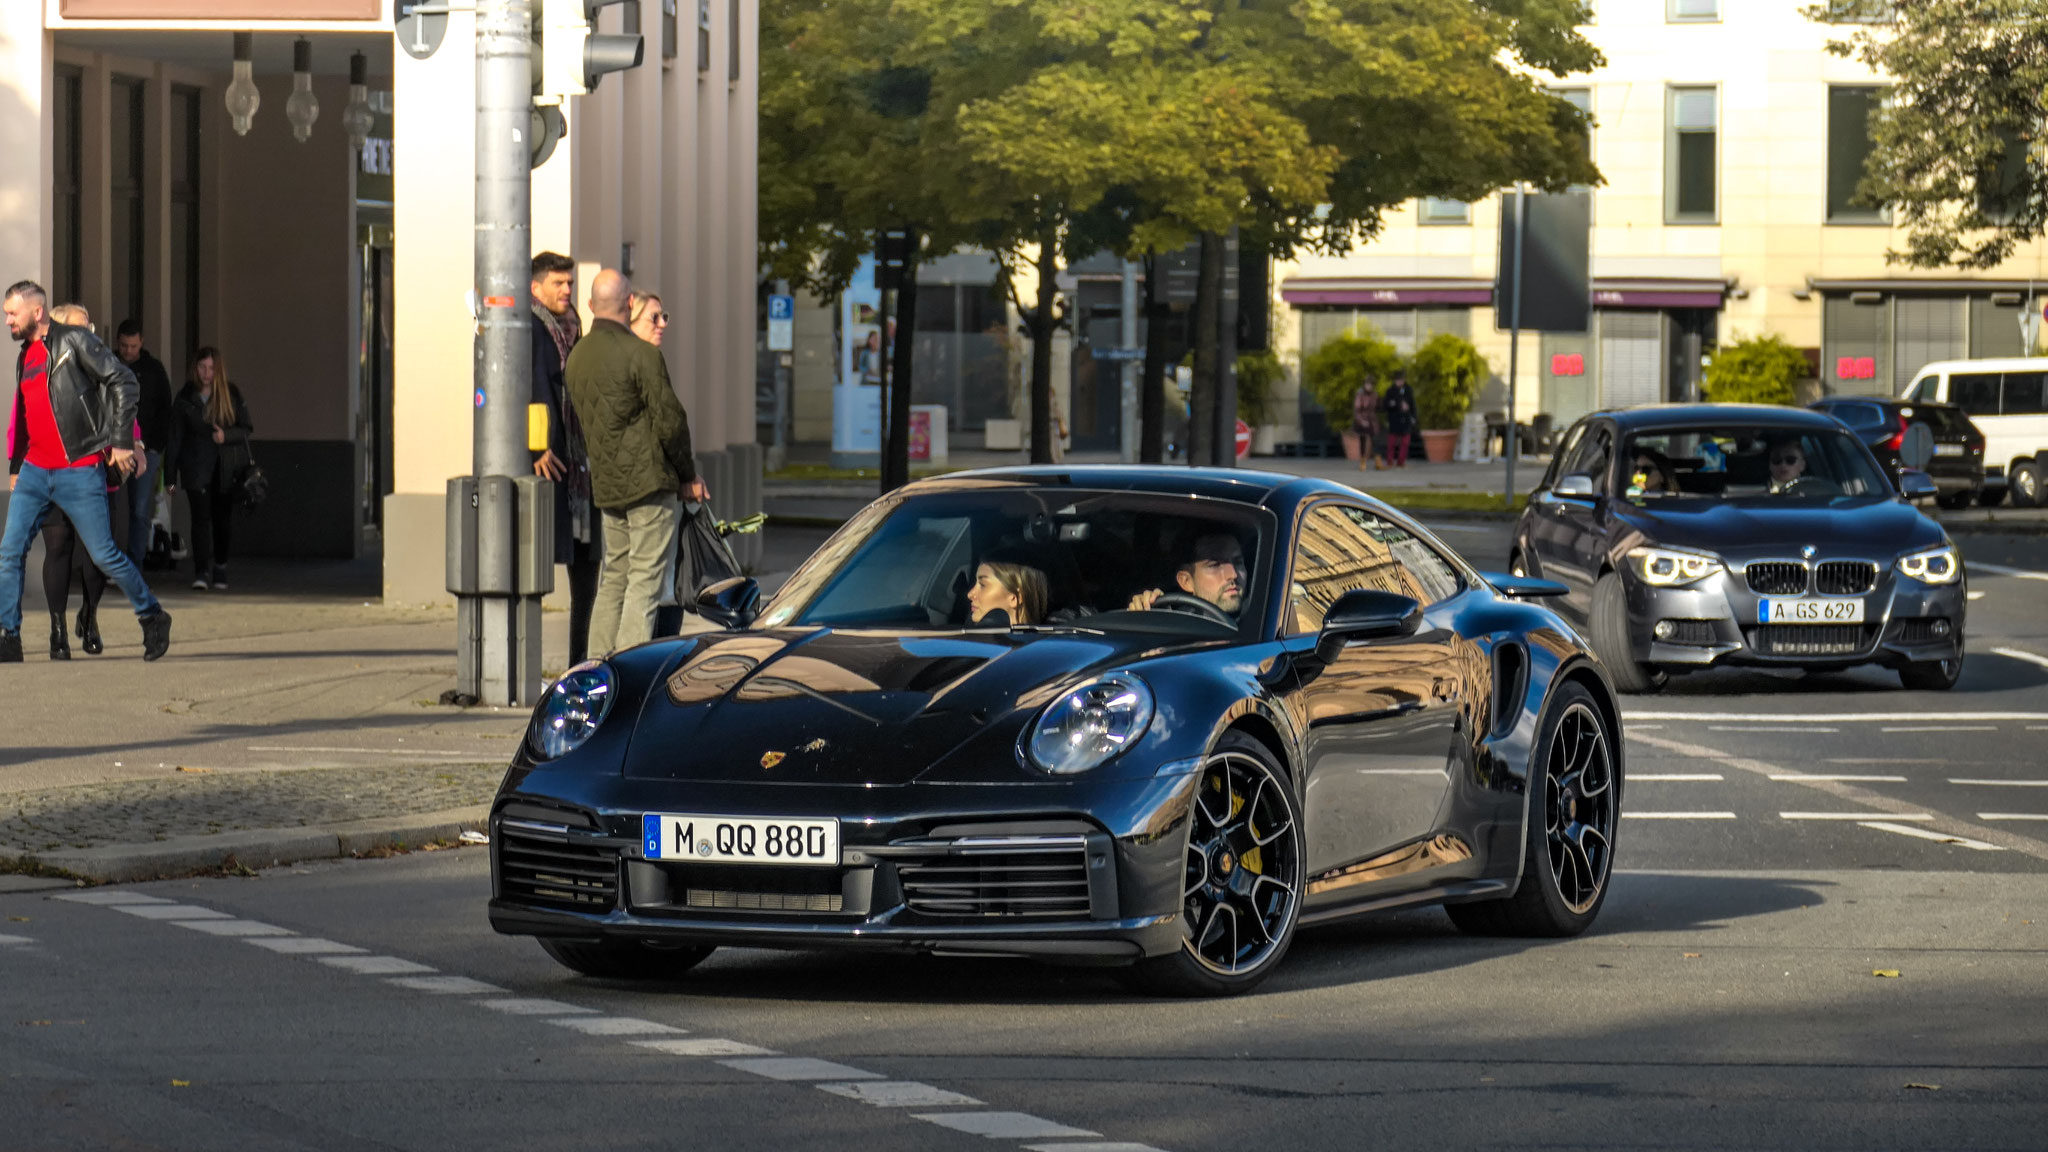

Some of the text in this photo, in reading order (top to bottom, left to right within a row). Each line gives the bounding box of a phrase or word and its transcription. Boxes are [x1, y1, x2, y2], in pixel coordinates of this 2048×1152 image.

[772, 297, 787, 318] P
[1775, 602, 1856, 619] A GS 629
[649, 840, 657, 851] D
[675, 821, 826, 858] M QQ 880
